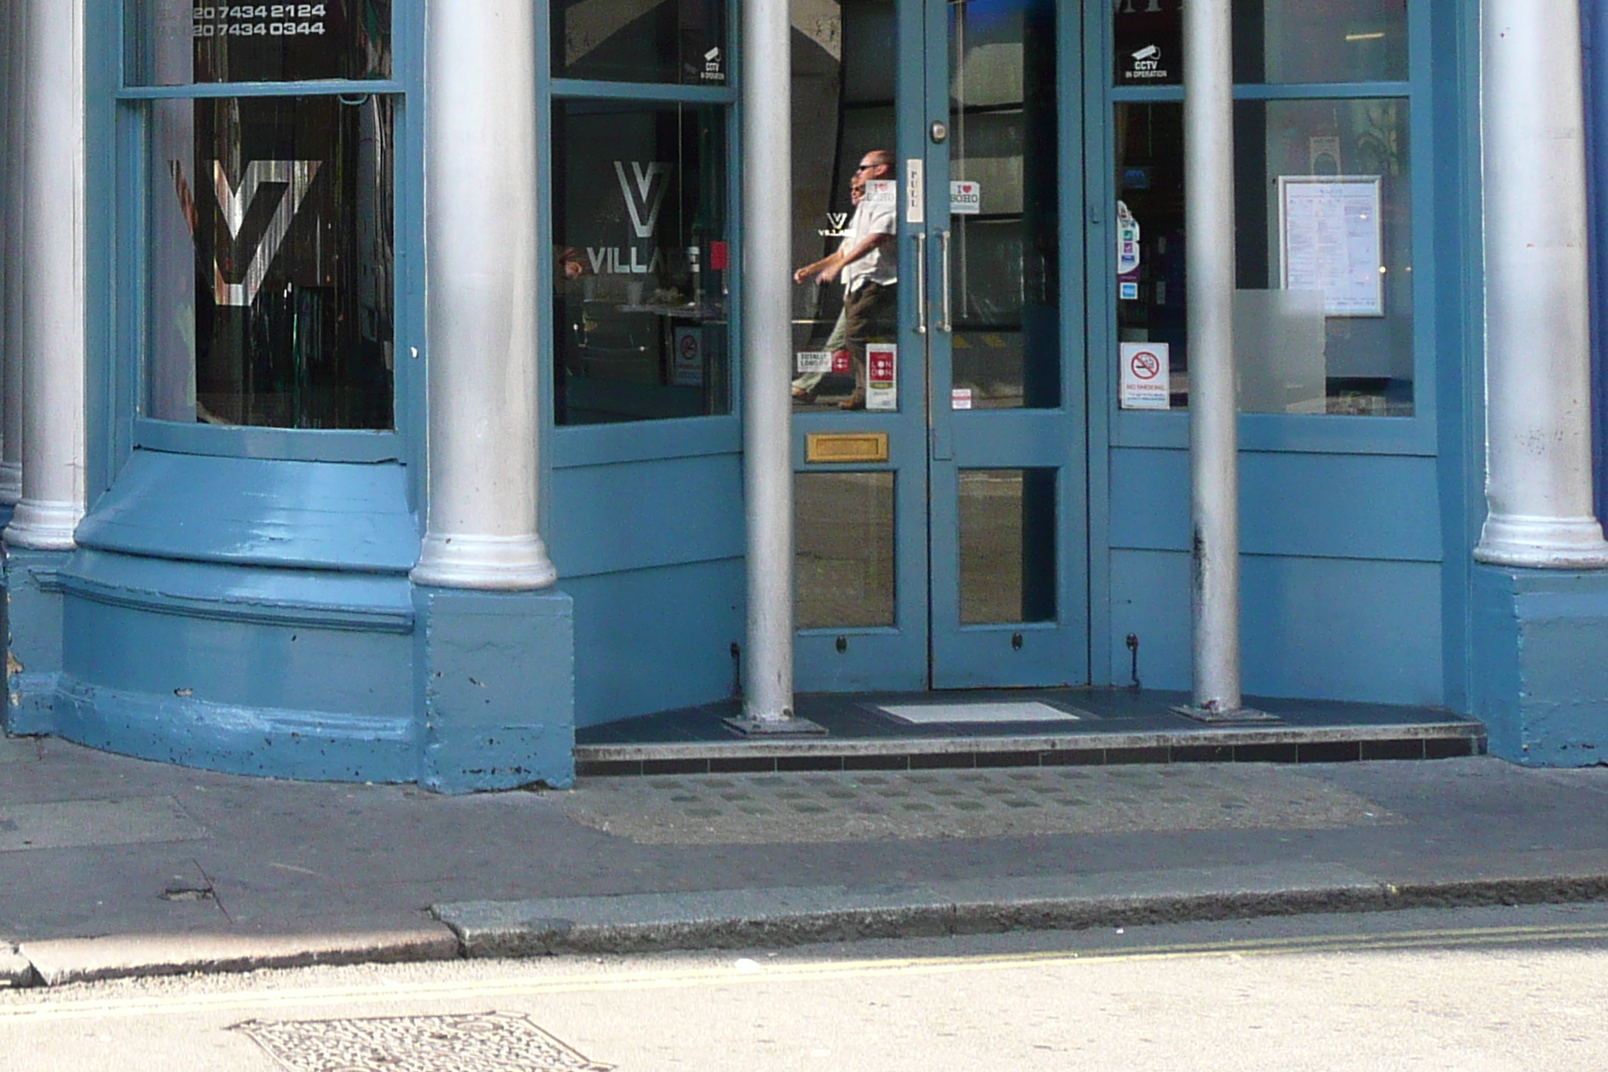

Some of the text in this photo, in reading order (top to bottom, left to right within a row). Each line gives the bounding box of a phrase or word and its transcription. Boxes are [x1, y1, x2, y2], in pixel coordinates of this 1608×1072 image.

[219, 5, 268, 19] 7434
[270, 4, 327, 18] 2124
[218, 23, 268, 36] 7434
[270, 22, 326, 36] 0344
[1134, 61, 1158, 70] CCTV
[1133, 70, 1167, 78] OPERATION
[911, 170, 919, 208] PULL
